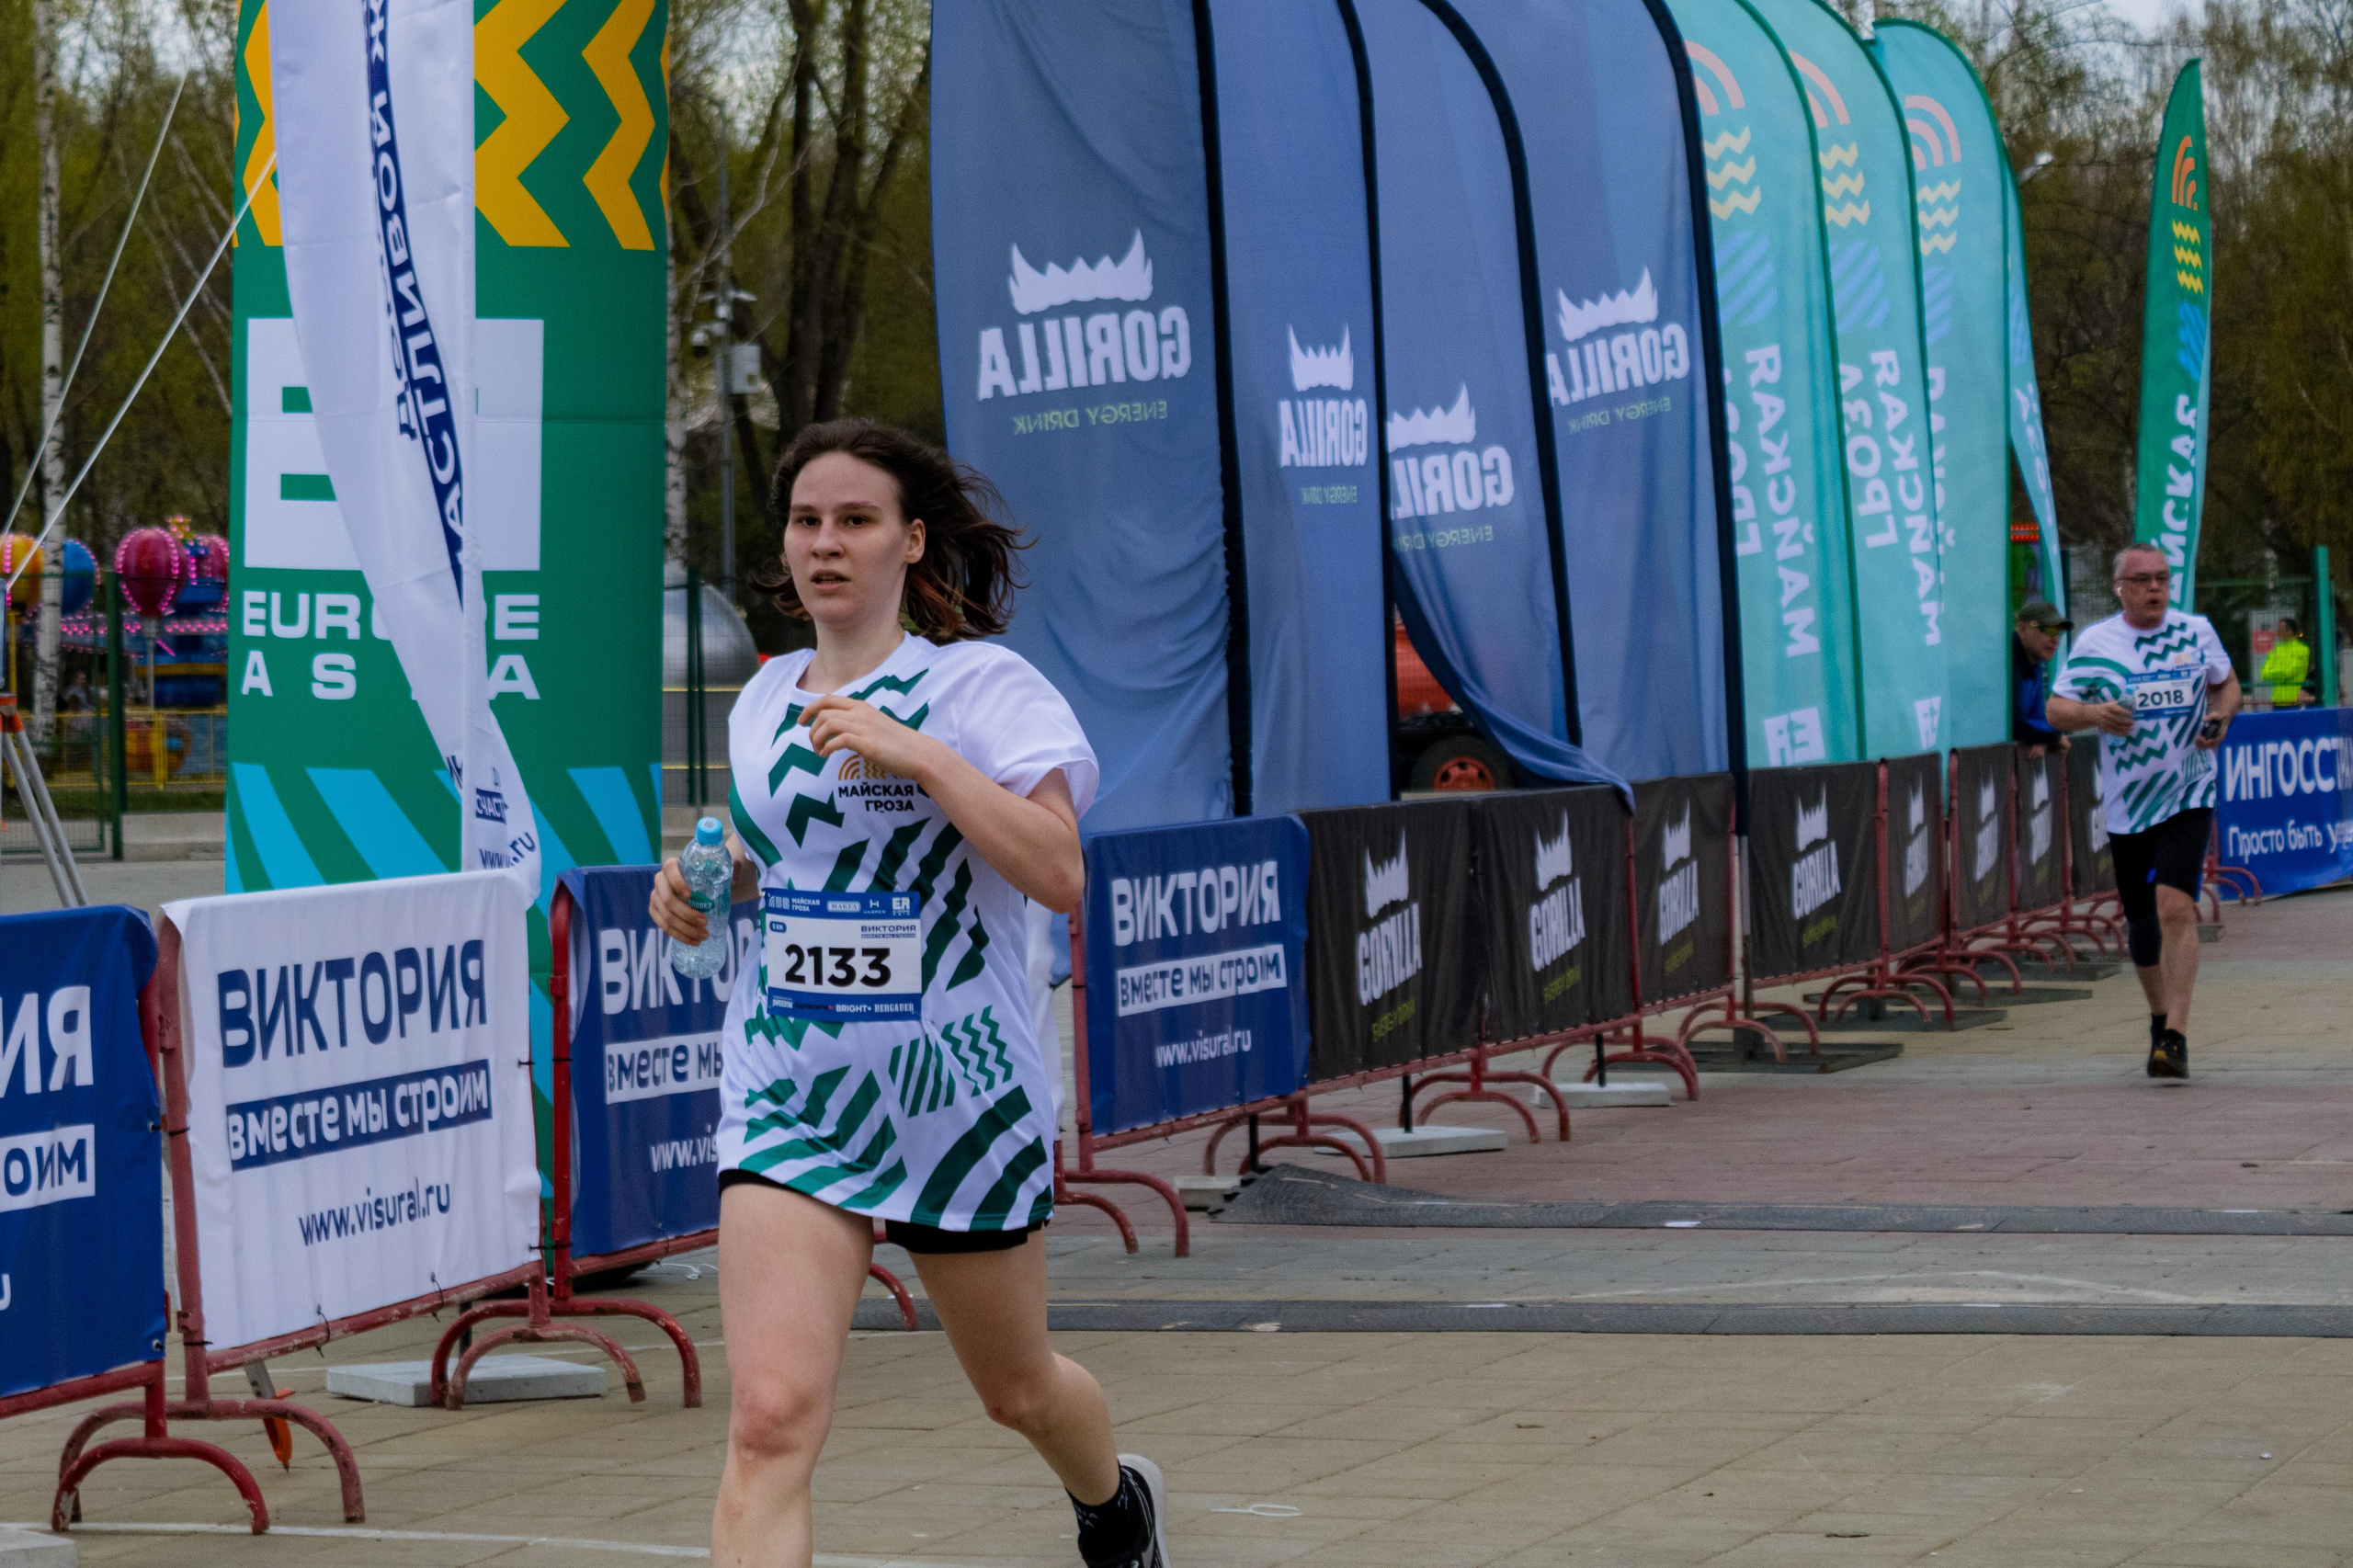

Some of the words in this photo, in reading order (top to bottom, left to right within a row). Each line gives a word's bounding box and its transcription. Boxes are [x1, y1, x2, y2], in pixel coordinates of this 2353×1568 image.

[243, 590, 540, 640] EURE
[2137, 690, 2184, 708] 2018
[838, 782, 914, 798] МАЙСКАЯ
[865, 800, 915, 812] ГРОЗА
[2229, 826, 2285, 864] Просто
[2288, 819, 2323, 850] быть
[1112, 861, 1281, 946] ВИКТОРИЯ
[1529, 878, 1586, 971] GORILLA
[860, 925, 916, 933] ВИКТОРИЯ
[1357, 902, 1423, 1006] GORILLA
[785, 944, 892, 987] 2133
[1120, 968, 1184, 1008] вместе
[1189, 963, 1215, 994] мы
[1220, 952, 1282, 995] строим
[217, 939, 488, 1069] ВИКТОРИЯ
[835, 1004, 869, 1013] BRIGHT
[608, 1043, 689, 1093] вместе
[1155, 1025, 1253, 1068] www.visural.ru
[227, 1096, 341, 1161] вместе
[346, 1088, 389, 1137] мы
[394, 1069, 490, 1133] строим
[298, 1176, 451, 1247] www.visural.ru
